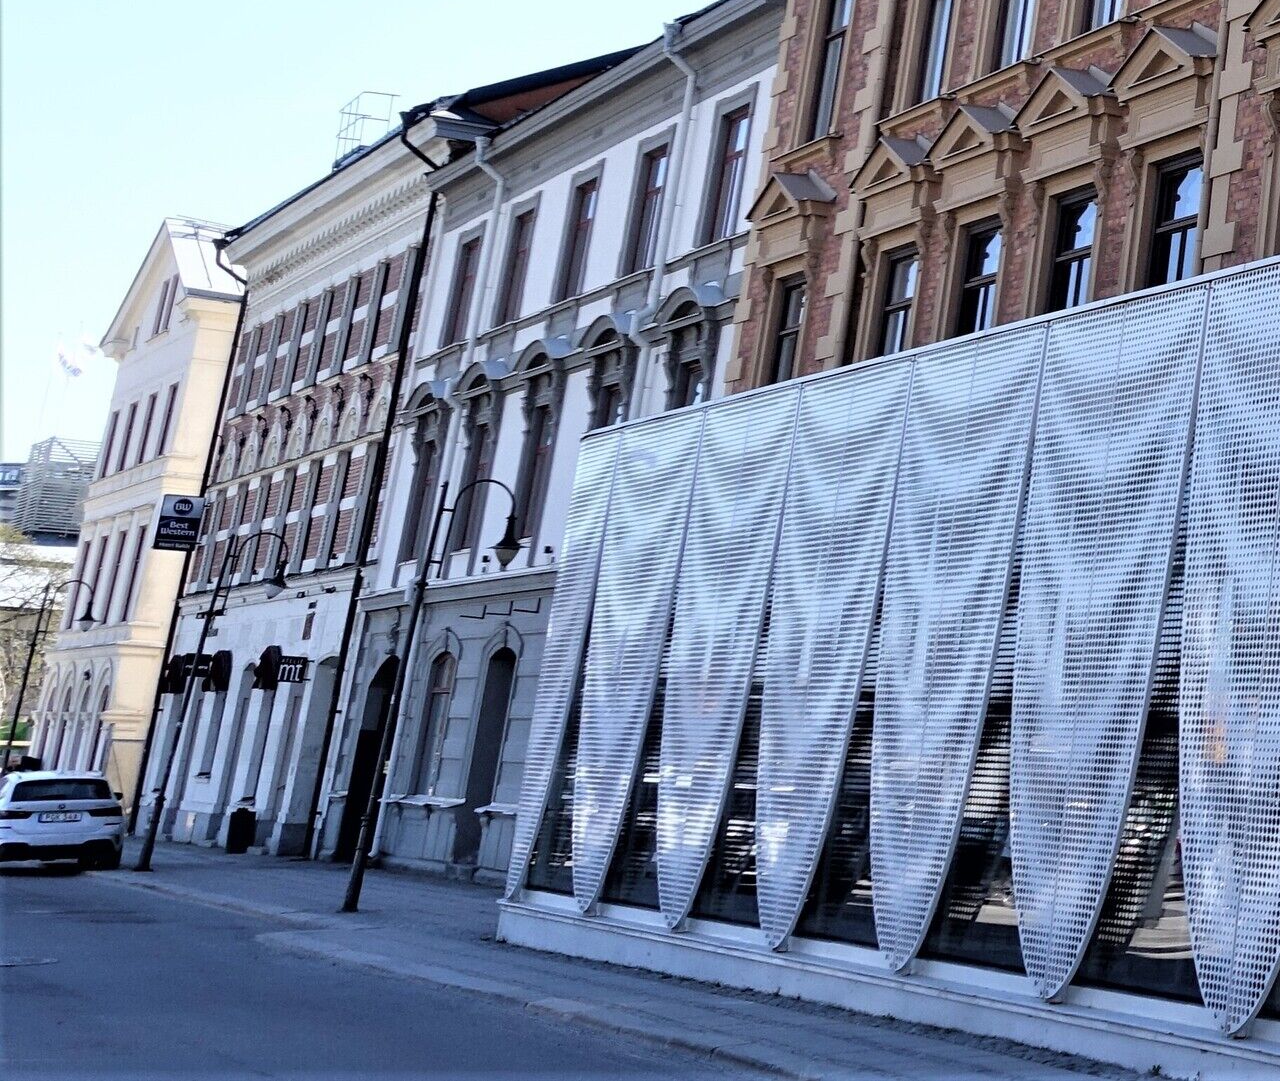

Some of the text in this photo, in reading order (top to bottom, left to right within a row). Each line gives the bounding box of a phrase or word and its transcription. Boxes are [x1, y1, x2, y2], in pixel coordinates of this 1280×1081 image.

[175, 502, 192, 511] BW
[170, 521, 188, 529] Best
[160, 527, 195, 536] Western
